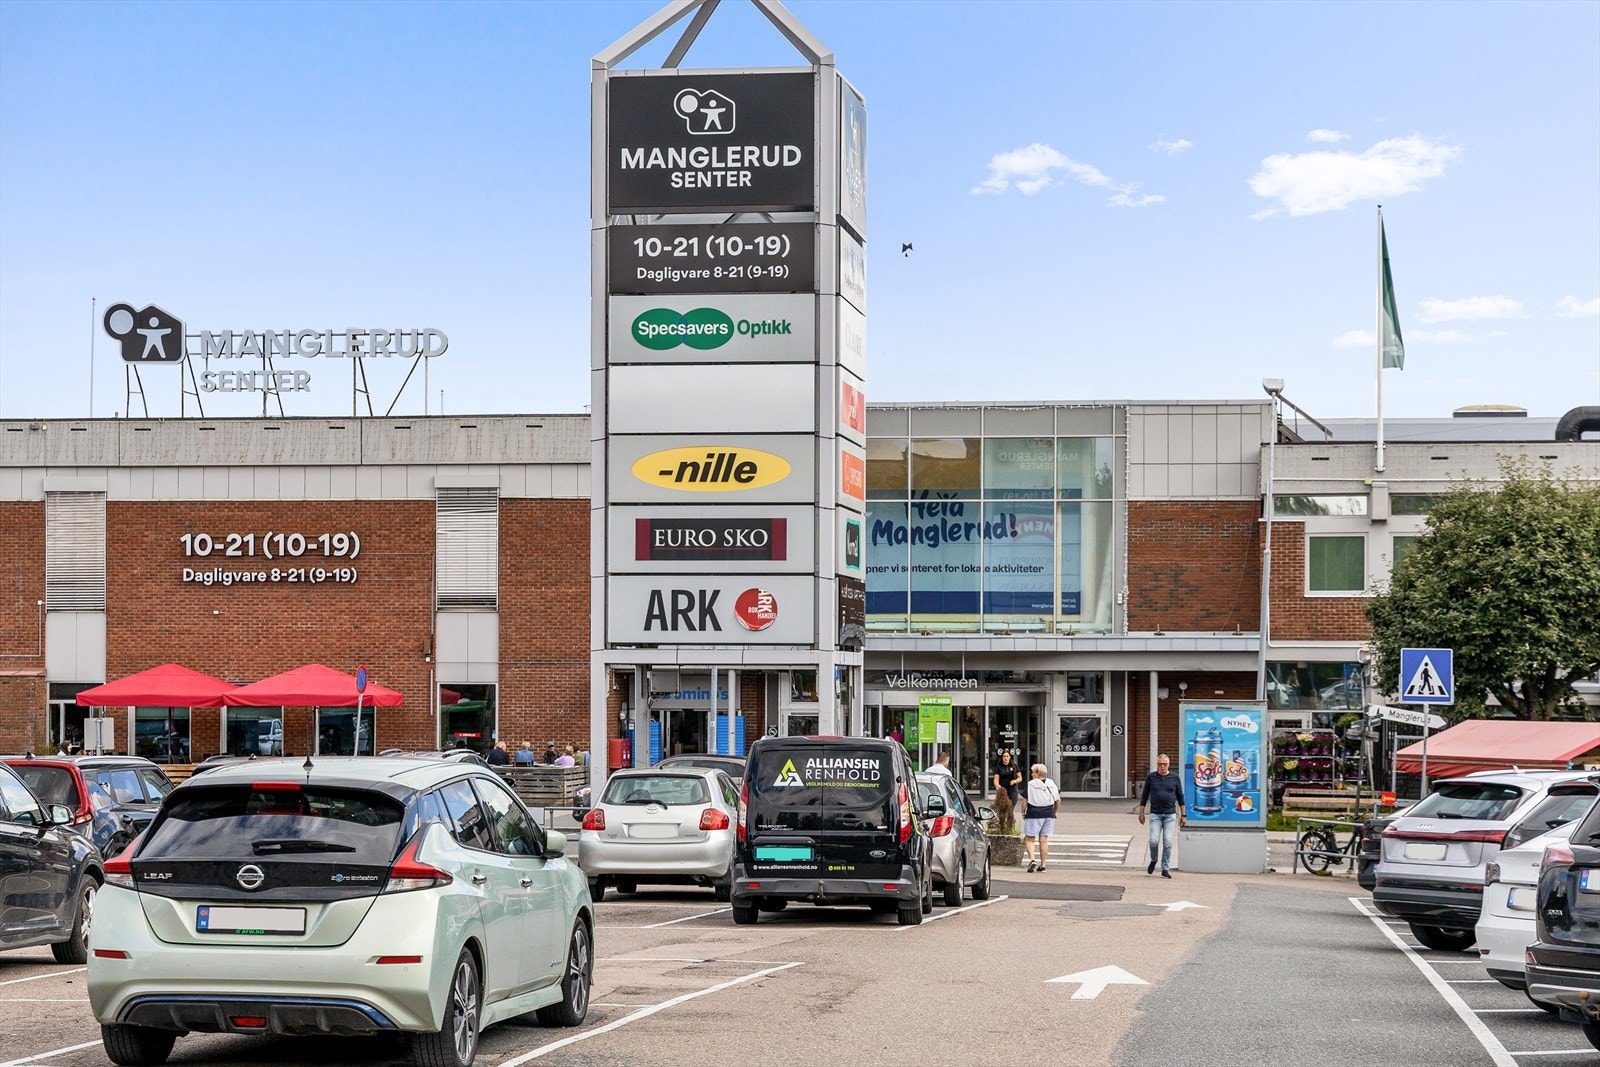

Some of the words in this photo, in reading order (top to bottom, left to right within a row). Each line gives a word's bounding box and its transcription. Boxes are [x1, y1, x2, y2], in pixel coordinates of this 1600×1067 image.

[620, 145, 802, 169] MANGLERUD
[671, 170, 752, 188] SENTER
[633, 236, 699, 257] 10-21
[706, 234, 790, 259] (10-19)
[637, 266, 710, 282] Dagligvare
[714, 266, 744, 278] 8-21
[747, 265, 789, 279] (9-19)
[638, 320, 728, 336] Specsavers
[737, 319, 792, 338] Optikk
[200, 328, 448, 358] MANGLERUD
[200, 370, 311, 392] SENTER
[654, 528, 717, 548] EURO
[723, 528, 769, 547] SKO
[872, 512, 1018, 548] Manglerud!
[180, 533, 256, 557] 10-21
[262, 531, 361, 560] (10-19)
[182, 568, 267, 585] Dagligvare
[271, 568, 305, 582] 8-21
[309, 567, 358, 585] (9-19)
[866, 564, 889, 575] pner
[891, 563, 899, 573] vi
[901, 564, 942, 573] snteret
[945, 563, 960, 573] for
[992, 563, 1044, 573] aktiviteter
[644, 589, 722, 632] ARK
[885, 674, 978, 689] Velkommen
[662, 686, 729, 700] omin's
[1227, 720, 1252, 729] NYHET
[806, 758, 880, 769] ALLIANSEN
[1194, 759, 1223, 779] Solo
[1227, 766, 1247, 777] Solo
[805, 769, 880, 780] RENHOLD
[143, 872, 173, 880] LEAF
